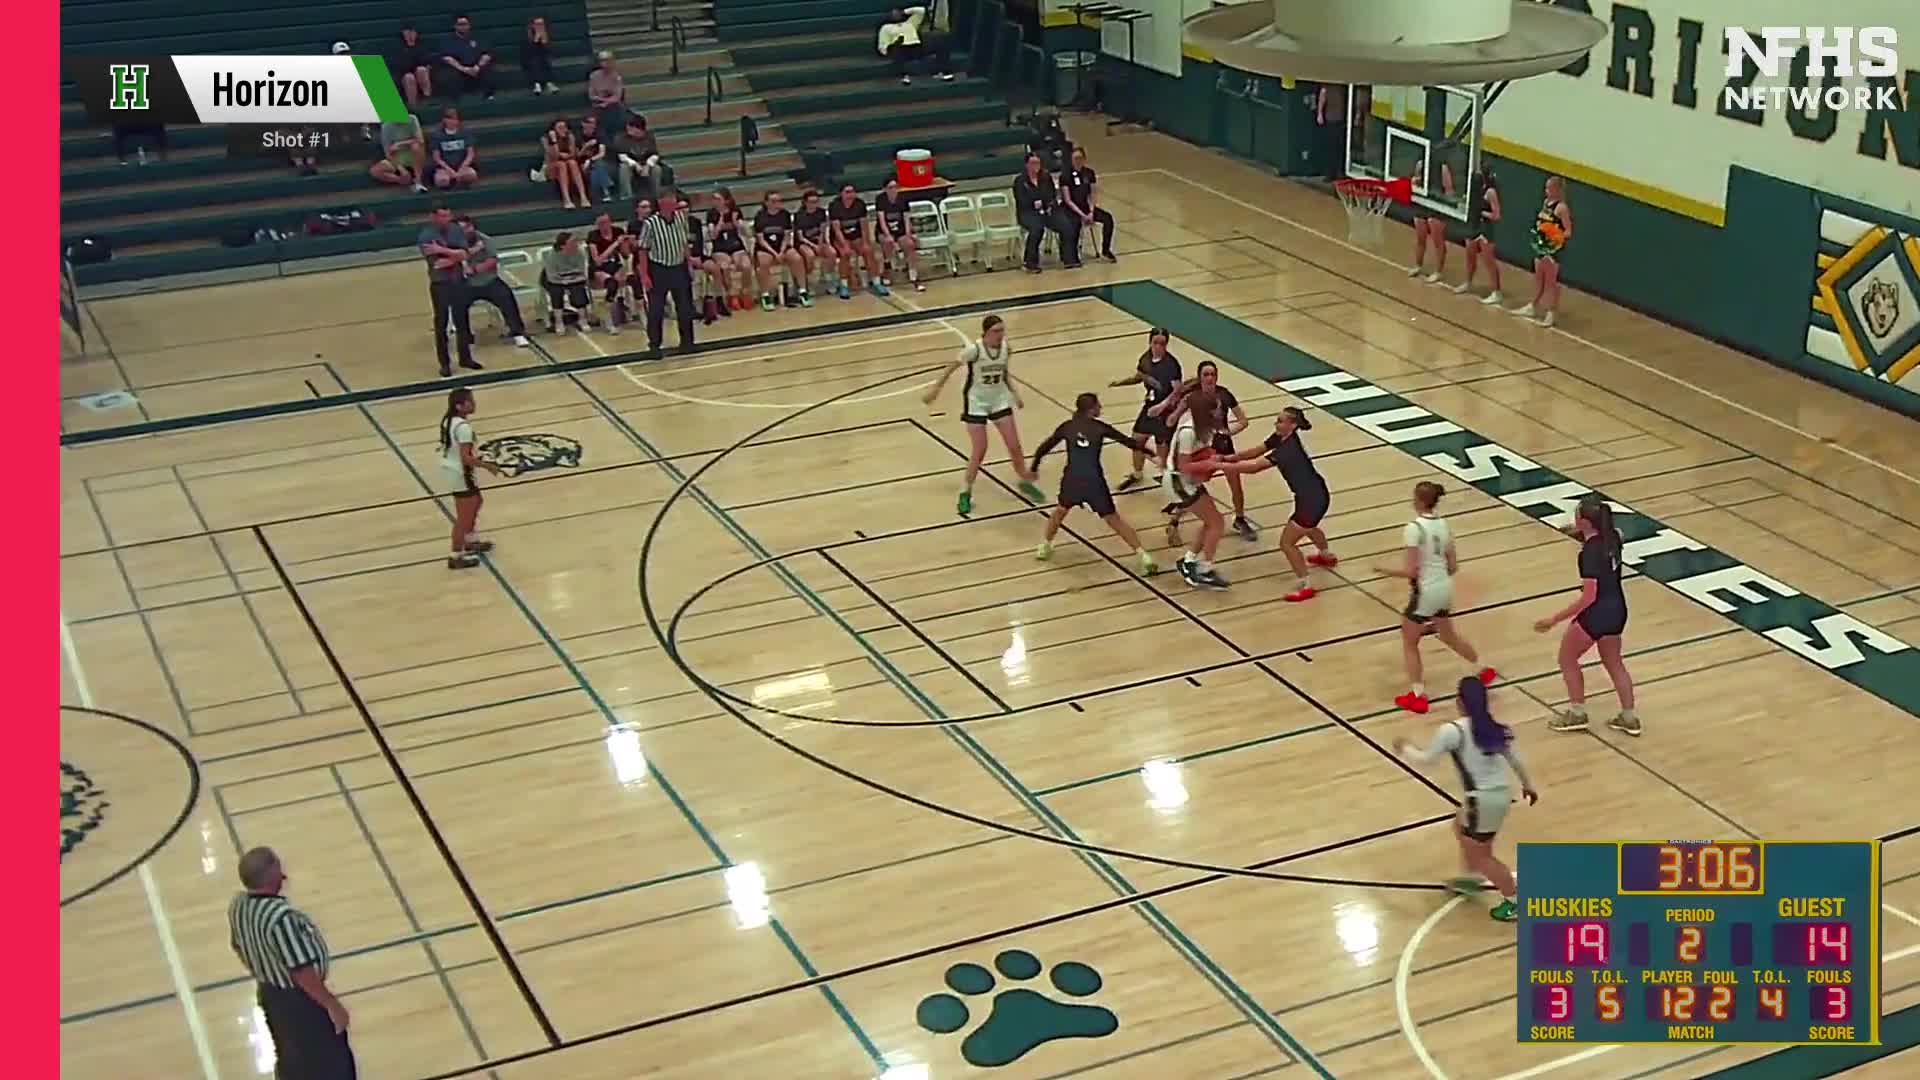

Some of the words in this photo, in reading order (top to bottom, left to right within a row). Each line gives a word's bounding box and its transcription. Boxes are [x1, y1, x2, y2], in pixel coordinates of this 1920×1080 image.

[1277, 371, 1912, 668] HUSKIES
[1659, 847, 1755, 889] 3:06
[1527, 897, 1613, 918] HUSKIES
[1665, 908, 1715, 922] PERIOD
[1778, 897, 1846, 918] GUEST
[1567, 924, 1606, 963] 19
[1679, 926, 1701, 961] 2
[1807, 926, 1848, 962] 14
[1530, 970, 1574, 984] FOULS
[1591, 970, 1629, 984] T.O.L.
[1642, 970, 1693, 984] PLAYER
[1703, 970, 1739, 985] FOUL
[1752, 970, 1791, 984] T.O.L.
[1807, 970, 1852, 984] FOULS
[1550, 987, 1568, 1019] 3
[1599, 987, 1621, 1019] 5
[1662, 987, 1695, 1019] 12
[1709, 987, 1732, 1019] 2
[1760, 987, 1783, 1018] 4
[1827, 987, 1847, 1019] 3
[1530, 1025, 1575, 1040] SCORE
[1668, 1025, 1715, 1040] MATCH
[1808, 1026, 1855, 1041] SCORE
